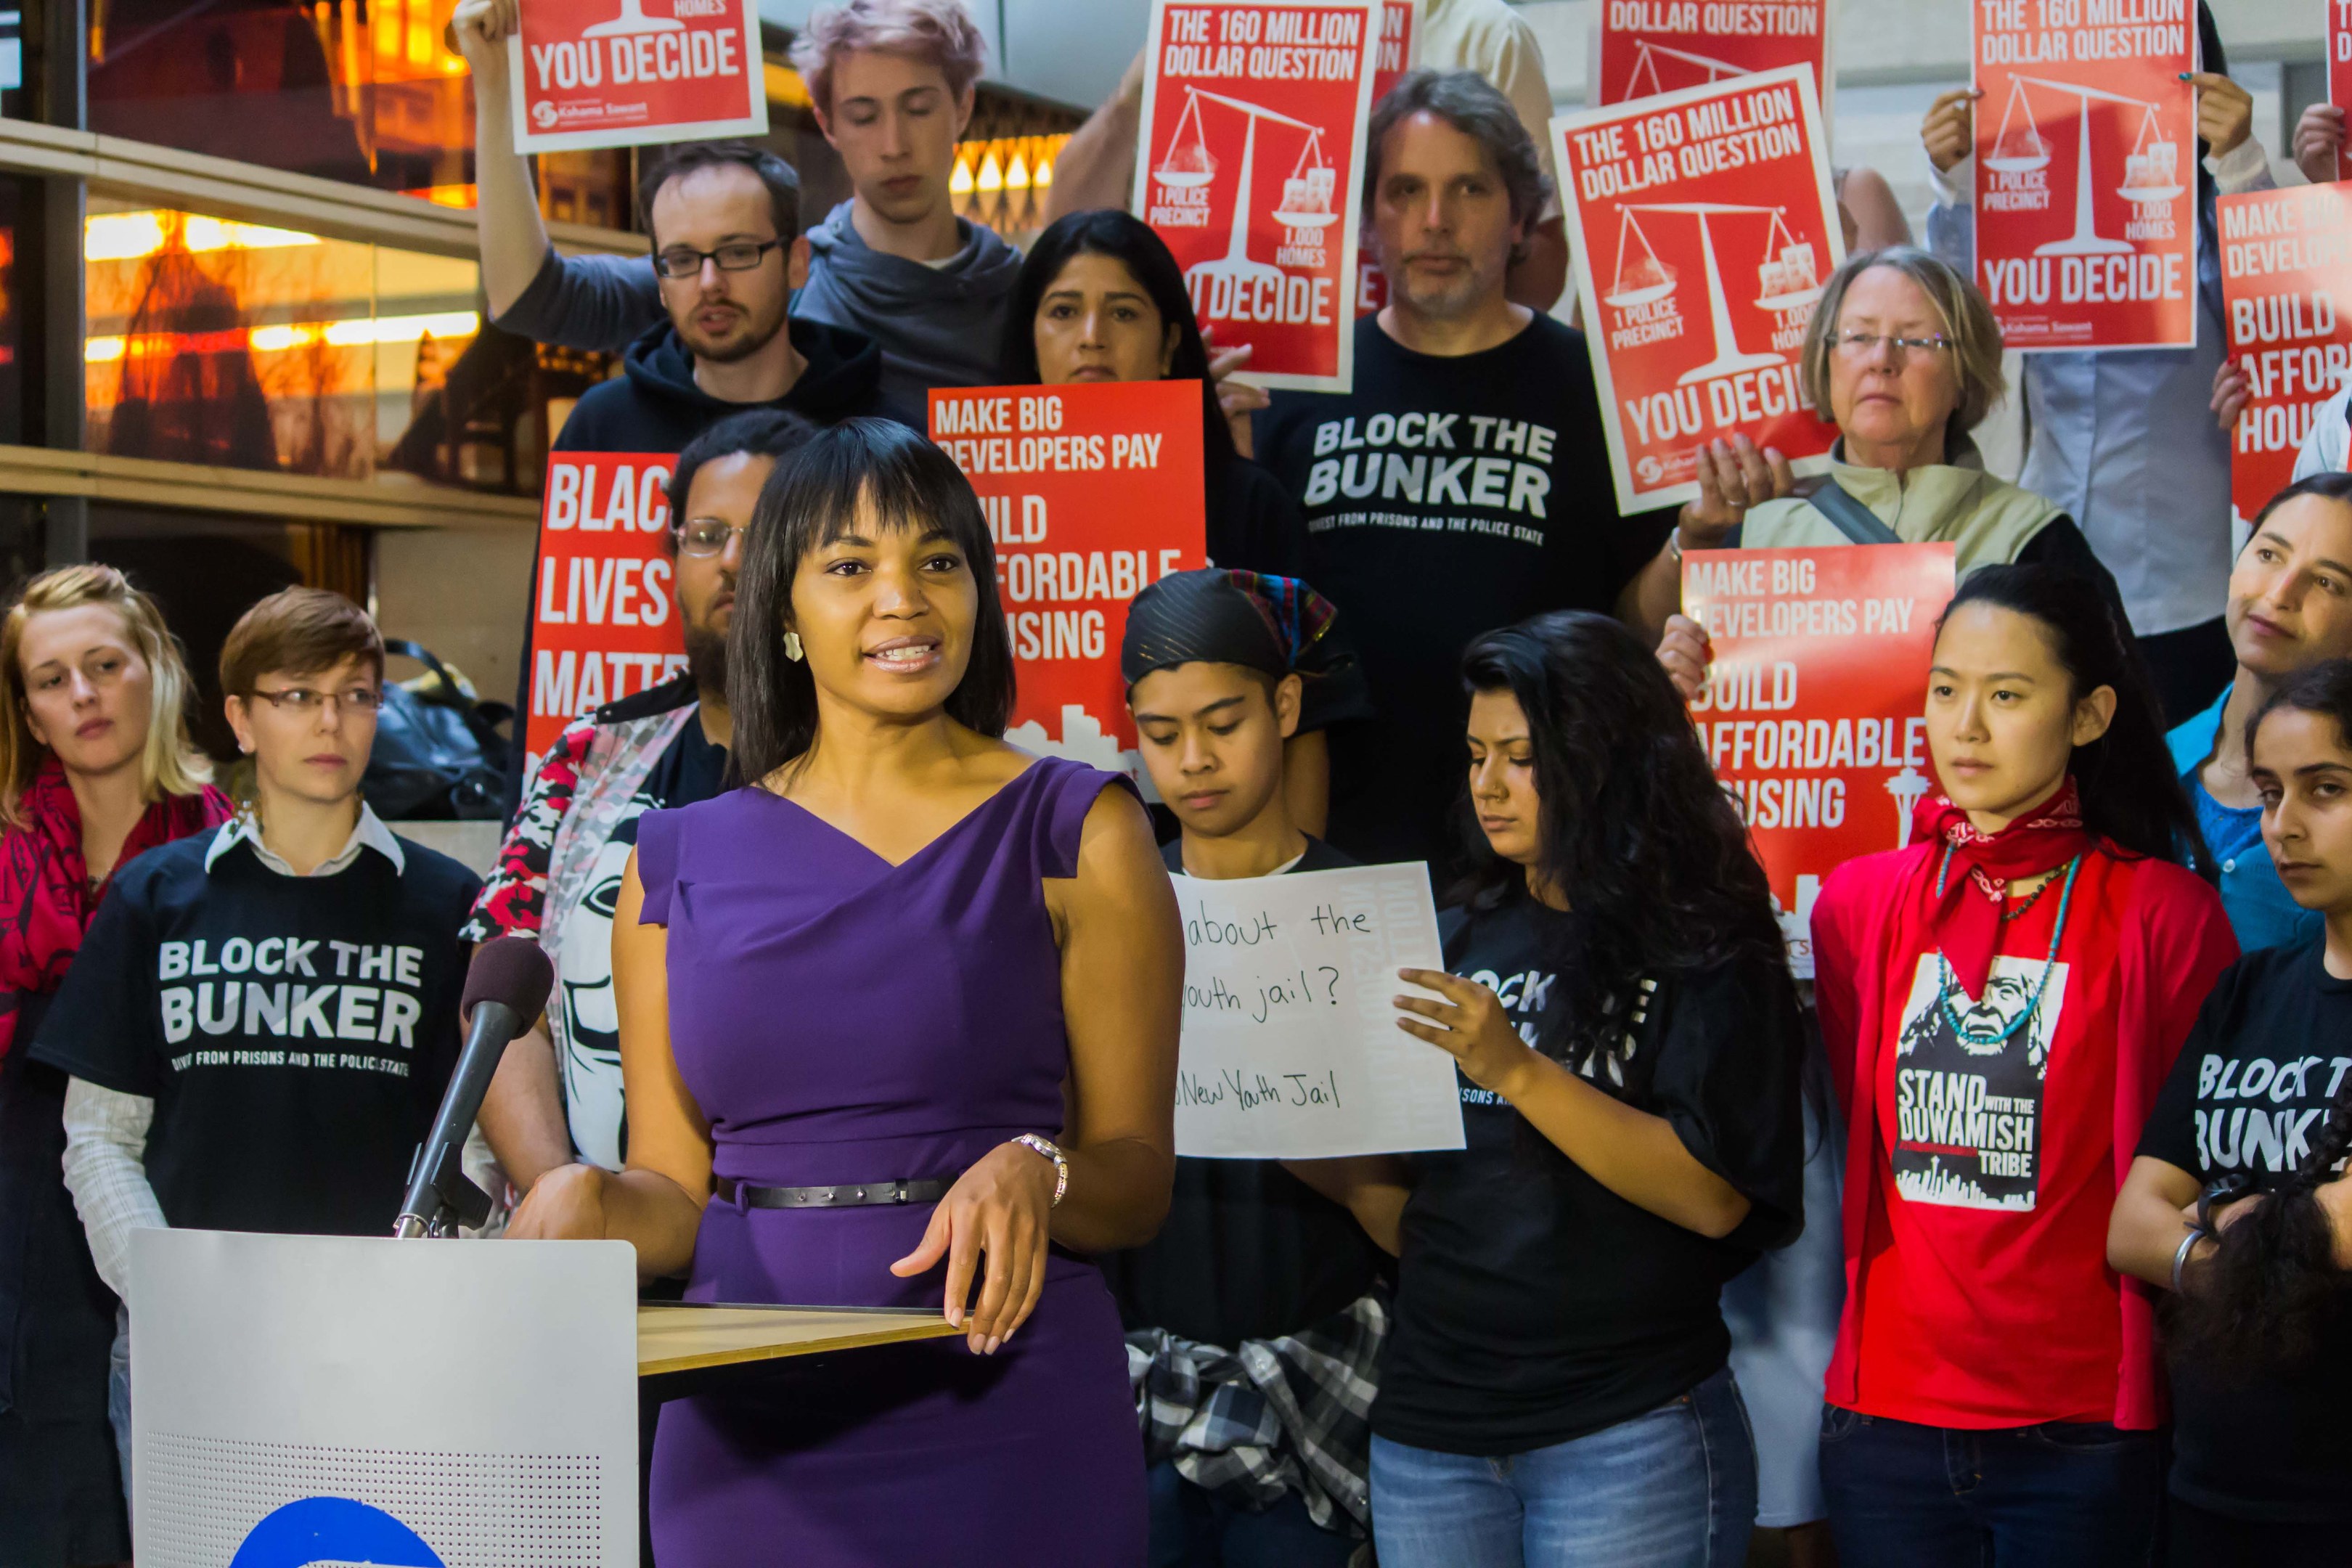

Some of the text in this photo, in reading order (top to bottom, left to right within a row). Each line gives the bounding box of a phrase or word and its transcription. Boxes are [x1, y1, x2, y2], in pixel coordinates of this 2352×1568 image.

[674, 0, 727, 18] HOMES
[1169, 10, 1213, 44] THE
[1219, 10, 1260, 44] 160
[1264, 12, 1360, 46] MILLION
[1610, 2, 1817, 36] DOLLAR QUESTION
[1980, 0, 2185, 31] THE 160 MILLION
[531, 28, 739, 91] YOU DECIDE
[1164, 46, 1244, 78] DOLLAR
[1248, 49, 1356, 81] QUESTION
[1982, 25, 2185, 65] DOLLAR QUESTION
[1574, 87, 1794, 167] THE 160 MILLION
[1581, 123, 1801, 203] DOLLAR QUESTION
[1999, 170, 2047, 191] POLICE
[1149, 206, 1211, 226] PRECINCT
[1164, 187, 1211, 205] POLICE
[1983, 189, 2049, 211] PRECINCT
[2126, 220, 2176, 240] HOMES
[2224, 199, 2298, 240] MAKE
[1275, 247, 1327, 267] HOMES
[1208, 273, 1334, 325] DECIDE
[1983, 254, 2184, 306] YOU DECIDE
[1625, 297, 1678, 327] POLICE
[2231, 290, 2337, 346] BUILD
[1611, 316, 1684, 351] PRECINCT
[1771, 324, 1809, 351] HOM
[935, 396, 1063, 434] MAKE BIG
[1625, 362, 1816, 446] YOU DECI
[1111, 433, 1163, 470] PAY
[1314, 412, 1557, 465] BLOCK THE
[547, 464, 672, 533] BLAC
[1304, 452, 1551, 520] BUNKER
[978, 495, 1047, 544] ILD
[1338, 512, 1367, 527] FROM
[1369, 512, 1418, 529] PRISONS
[1421, 516, 1444, 531] AND
[1447, 517, 1466, 532] THE
[1471, 518, 1511, 537] POLICE
[1514, 526, 1544, 547] STATE
[539, 557, 672, 627] LIVES
[1689, 558, 1816, 597] MAKE BIG
[1007, 610, 1106, 661] SING
[1863, 597, 1914, 634] PAY
[534, 650, 690, 717] MATT
[1718, 777, 1846, 829] USING
[1188, 899, 1371, 947] about the
[159, 936, 425, 988] BLOCK THE
[160, 981, 421, 1049] BUNKER
[196, 1050, 229, 1066] FROM
[233, 1050, 285, 1066] PRISONS
[288, 1051, 310, 1067] AND
[314, 1053, 336, 1068] THE
[2197, 1053, 2324, 1103] BLOCK
[1181, 1070, 1223, 1107] New
[1283, 1070, 1340, 1109] Jail
[1898, 1069, 2035, 1115] STAND WITH THE
[1899, 1106, 2033, 1152] DUWAMISH
[2194, 1107, 2339, 1172] BUNK
[1978, 1150, 2033, 1178] TRIBE
